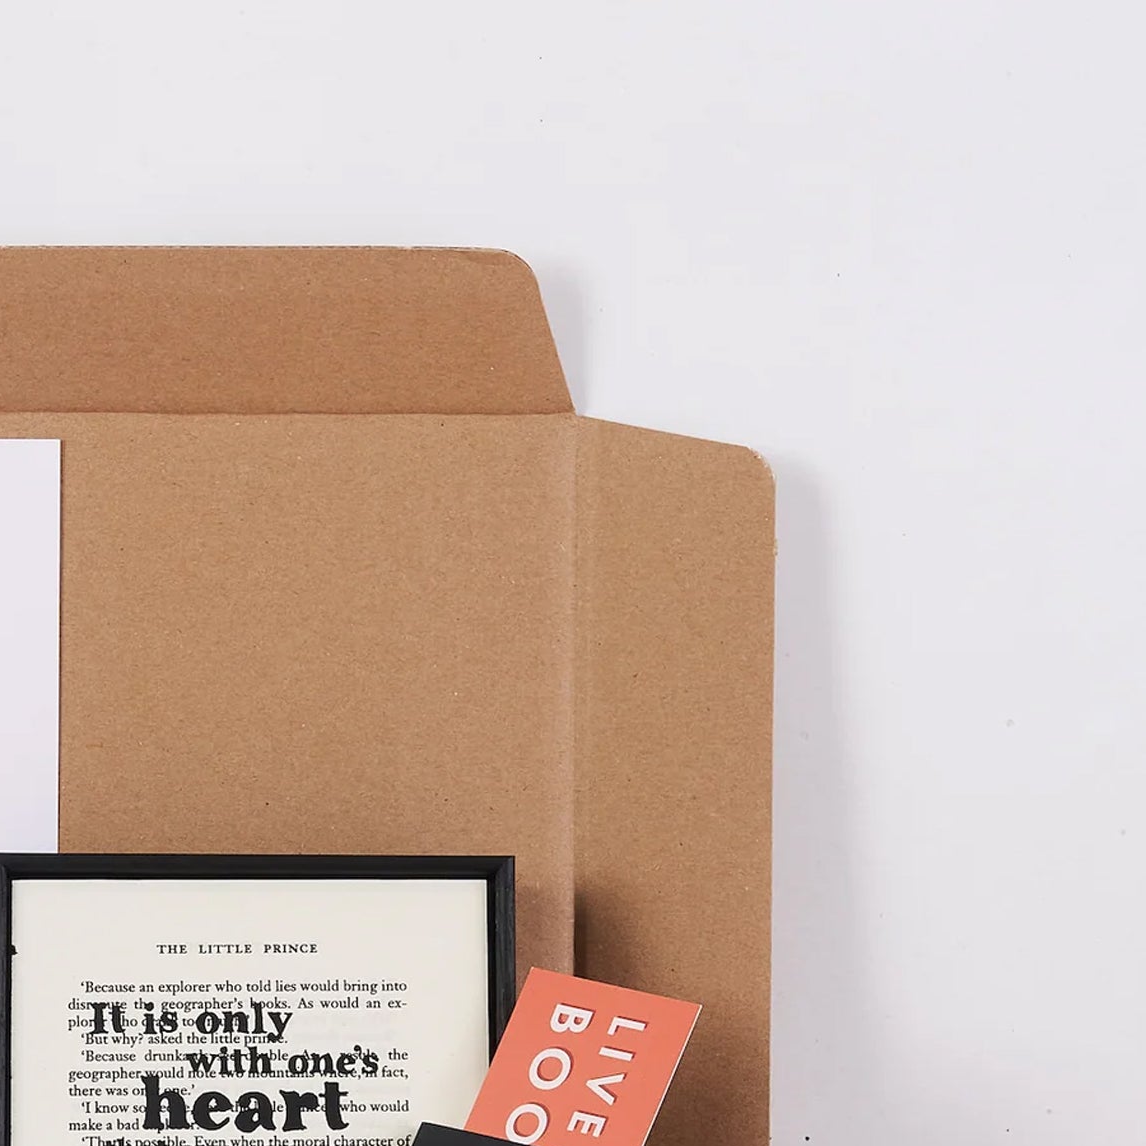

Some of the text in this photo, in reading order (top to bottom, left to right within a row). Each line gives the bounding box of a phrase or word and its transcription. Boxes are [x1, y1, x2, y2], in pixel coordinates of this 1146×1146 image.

[156, 943, 318, 955] THE LITTLE PRINCE
[80, 980, 407, 996] 'Because an explorer who told lies would bring into
[161, 998, 243, 1013] geographer's
[298, 998, 314, 1009] As
[320, 997, 359, 1009] would
[366, 1000, 381, 1009] an
[388, 1000, 407, 1009] ex-
[89, 1002, 125, 1034] It
[144, 1002, 179, 1034] is
[196, 1001, 293, 1042] only
[112, 1033, 144, 1047] why?
[148, 1032, 183, 1044] asked
[187, 1033, 207, 1044] the
[210, 1032, 240, 1044] little
[81, 1050, 136, 1061] 'Because
[388, 1048, 408, 1060] the
[186, 1046, 272, 1075] with
[288, 1045, 379, 1075] one's
[69, 1067, 141, 1082] geographer
[381, 1066, 408, 1079] fact,
[567, 1015, 649, 1138] LIVE
[69, 1084, 102, 1096] there
[105, 1087, 129, 1096] was
[94, 1101, 129, 1113] know
[340, 1100, 366, 1112] who
[370, 1100, 409, 1112] would
[141, 1075, 349, 1133] heart
[69, 1119, 102, 1130] make
[106, 1122, 113, 1130] a
[116, 1118, 139, 1130] bad
[230, 1136, 264, 1146] when
[269, 1135, 290, 1146] the
[293, 1135, 330, 1146] moral
[333, 1135, 393, 1146] character
[397, 1135, 412, 1146] of
